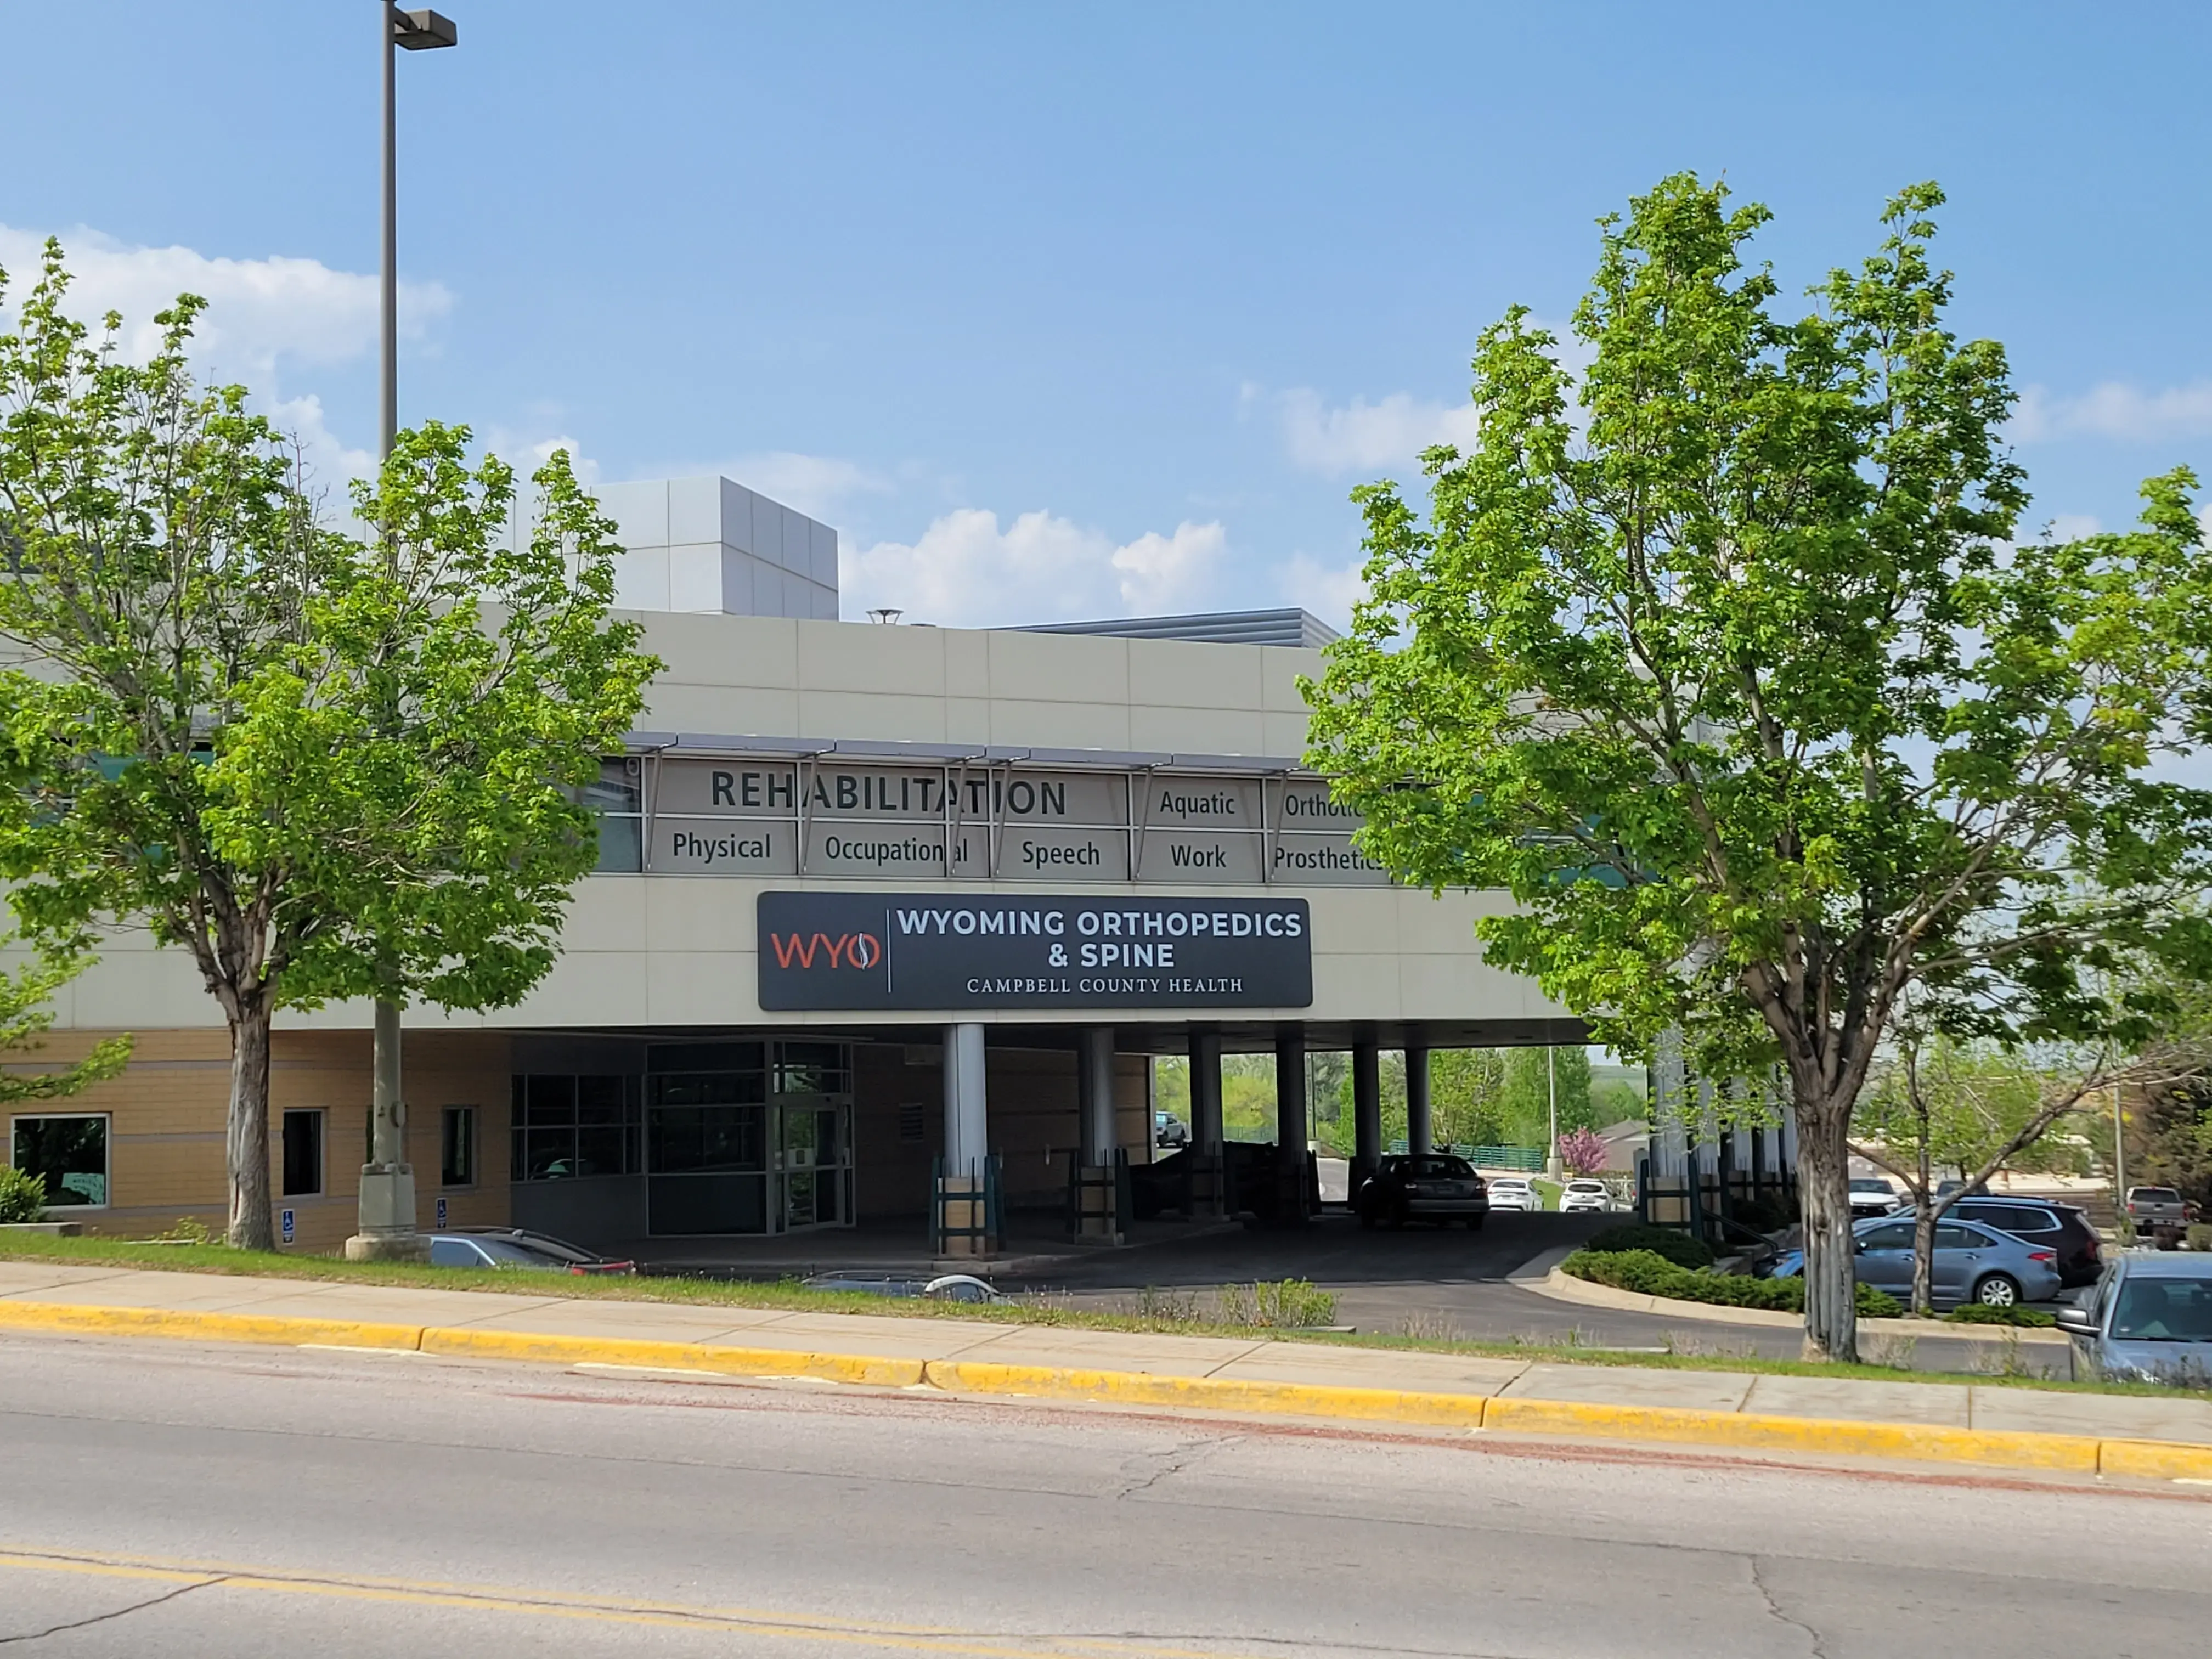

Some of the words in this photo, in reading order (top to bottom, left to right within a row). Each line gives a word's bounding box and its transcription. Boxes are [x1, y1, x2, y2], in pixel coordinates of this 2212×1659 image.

[713, 770, 1065, 815] REHABILITATION
[1160, 791, 1235, 820] Aquatic
[673, 832, 770, 864] Physical
[826, 836, 968, 866] Occupational
[1023, 841, 1099, 870] Speech
[1170, 844, 1227, 867] Work
[896, 910, 1064, 935] WYOMING
[1077, 911, 1301, 937] ORTHOPEDICS
[771, 932, 881, 970] WYO
[1048, 943, 1068, 967] &
[1080, 943, 1175, 967] SPINE
[967, 978, 1071, 993] CAMPBELL
[1079, 979, 1161, 993] COUNTY
[1169, 979, 1243, 993] HEALTH
